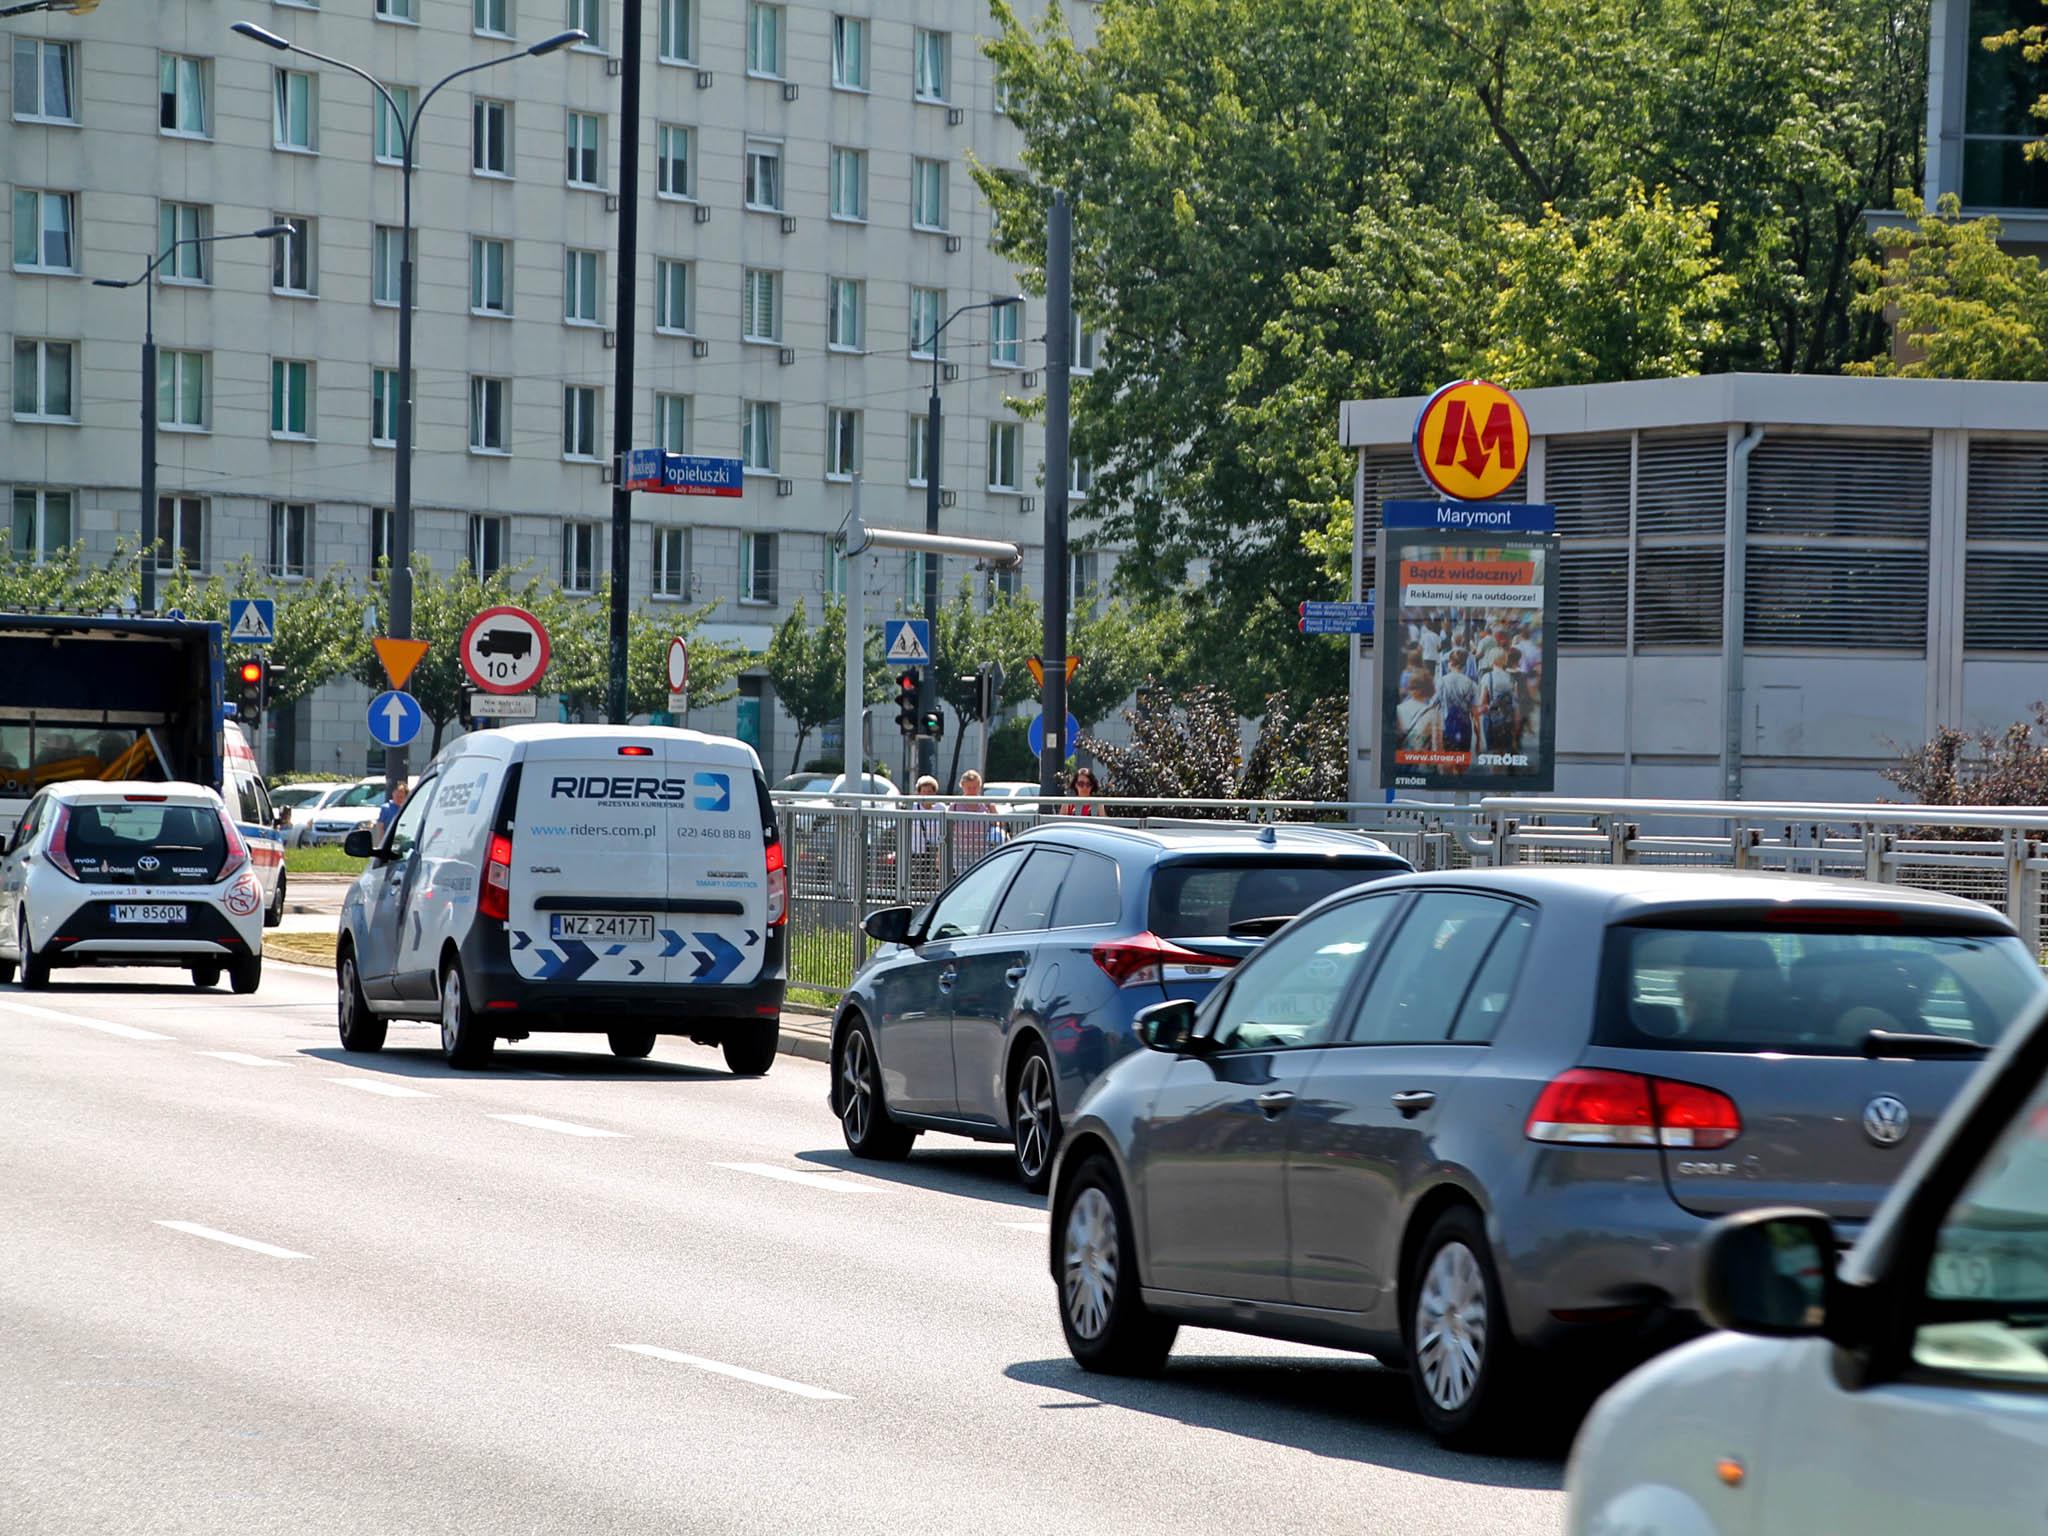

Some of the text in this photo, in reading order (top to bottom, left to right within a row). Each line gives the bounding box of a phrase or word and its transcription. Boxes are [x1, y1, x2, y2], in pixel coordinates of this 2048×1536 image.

[1436, 507, 1511, 527] Marymont
[1409, 565, 1523, 583] Bądź widoczny!
[1410, 589, 1454, 600] Reklamuj
[1455, 590, 1468, 601] się
[1484, 591, 1536, 602] outdoorze!
[487, 661, 518, 678] 10 t
[1404, 752, 1528, 766] www.stroer.pl STRÖER
[1395, 776, 1427, 785] STRÖER
[551, 776, 686, 800] RIDERS
[641, 801, 685, 809] KURIERSKIE
[530, 824, 656, 839] www.riders.com.pl
[677, 827, 751, 840] (22) 460 88 88
[172, 866, 208, 874] WARSZAWA
[530, 866, 561, 874] DACIA
[118, 906, 184, 920] WY 8560K
[563, 918, 649, 935] WZ 2417T
[1678, 1161, 1737, 1176] GOLF
